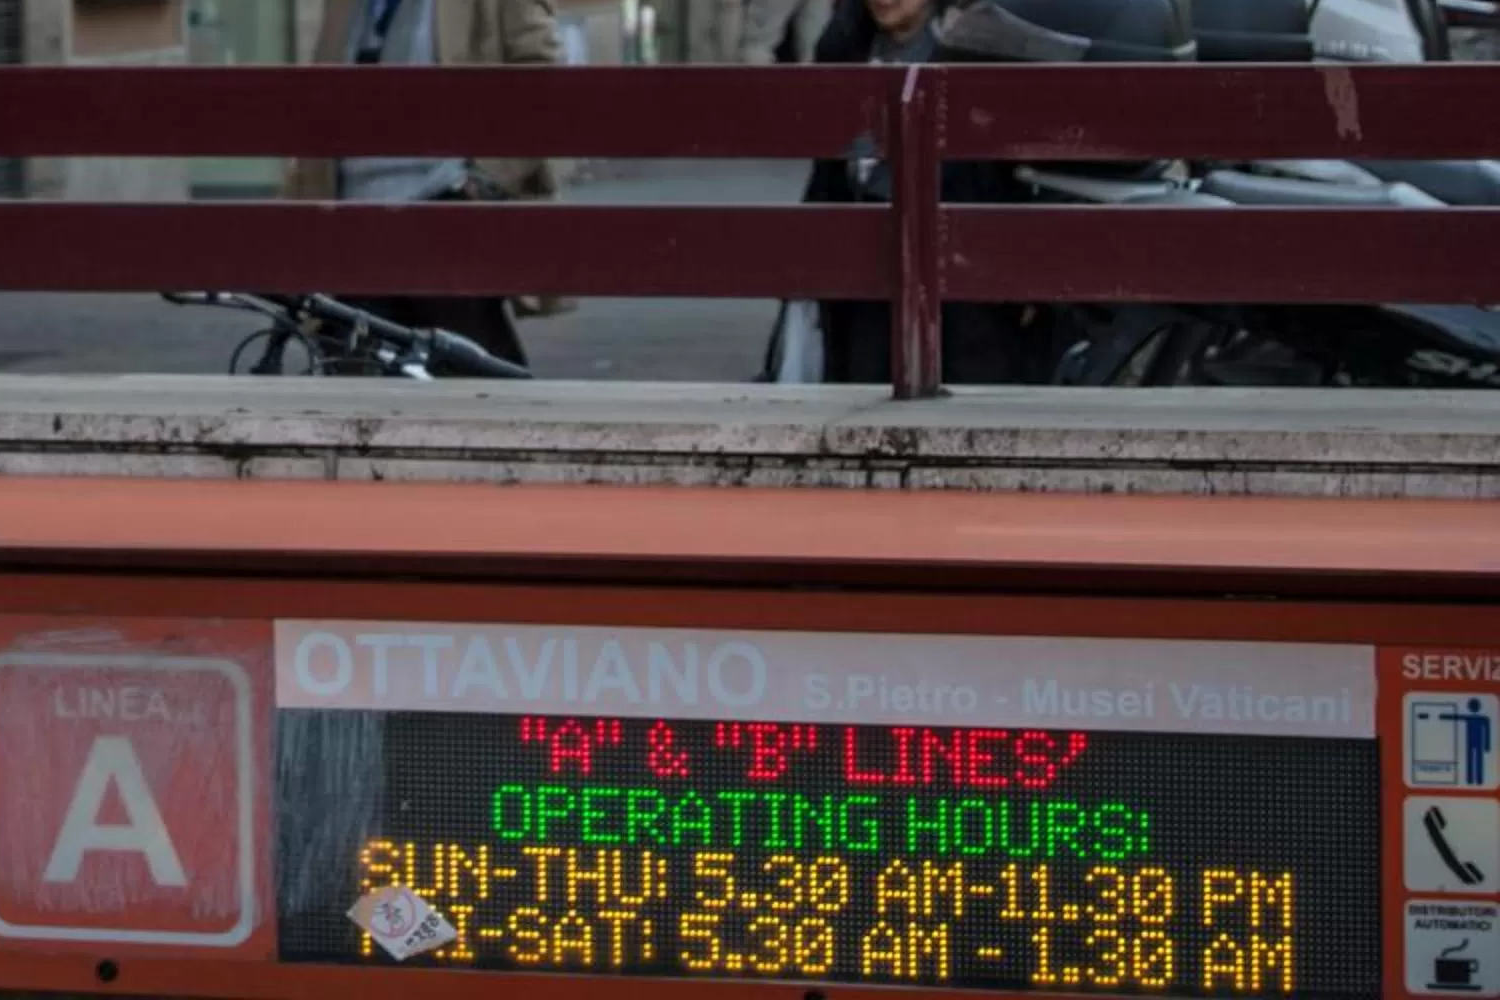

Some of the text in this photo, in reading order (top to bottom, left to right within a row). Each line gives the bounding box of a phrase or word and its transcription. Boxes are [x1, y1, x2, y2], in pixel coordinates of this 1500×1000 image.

[53, 684, 174, 722] LINEA
[294, 631, 766, 706] OTTAVIANO
[802, 672, 977, 712] S.Pietro
[1021, 679, 1155, 720] Musei
[1169, 681, 1352, 724] Vaticani
[647, 719, 690, 778] &
[43, 733, 188, 888] A
[494, 784, 1150, 860] OPERATING HOURS:
[359, 840, 668, 905] SUN-THU:
[694, 850, 849, 913] 5.30
[1202, 869, 1293, 928] PM
[361, 902, 653, 966] I-SAT:
[679, 912, 834, 976] 5.30
[862, 921, 949, 979] AM
[1030, 926, 1175, 986] 1.30
[1201, 933, 1293, 992] AM
